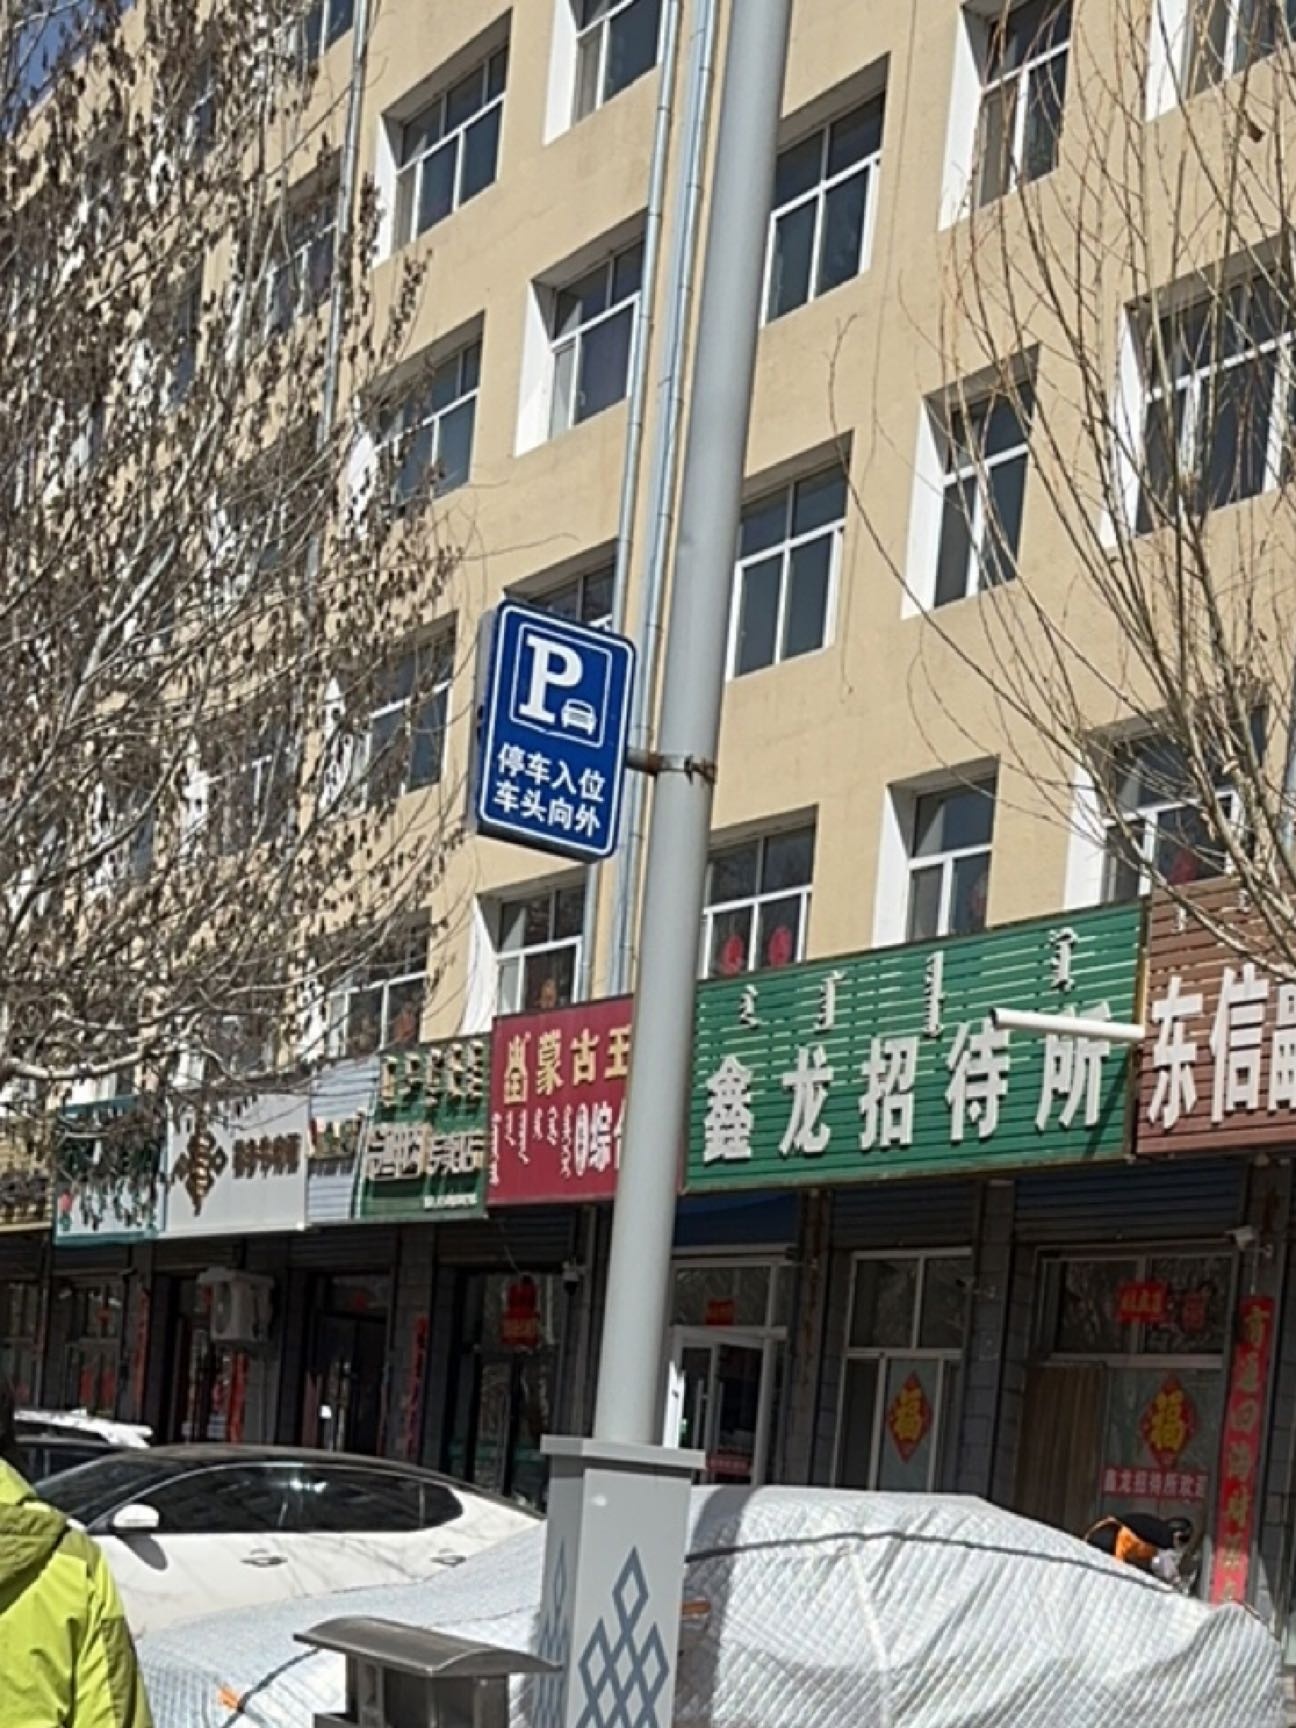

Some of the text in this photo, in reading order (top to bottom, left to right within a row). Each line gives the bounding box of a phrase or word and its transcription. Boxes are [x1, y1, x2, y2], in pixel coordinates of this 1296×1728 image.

[518, 633, 584, 724] P
[493, 780, 601, 838] 车头向外
[497, 742, 606, 803] 停车入位
[703, 1001, 1113, 1164] 鑫龙招待所
